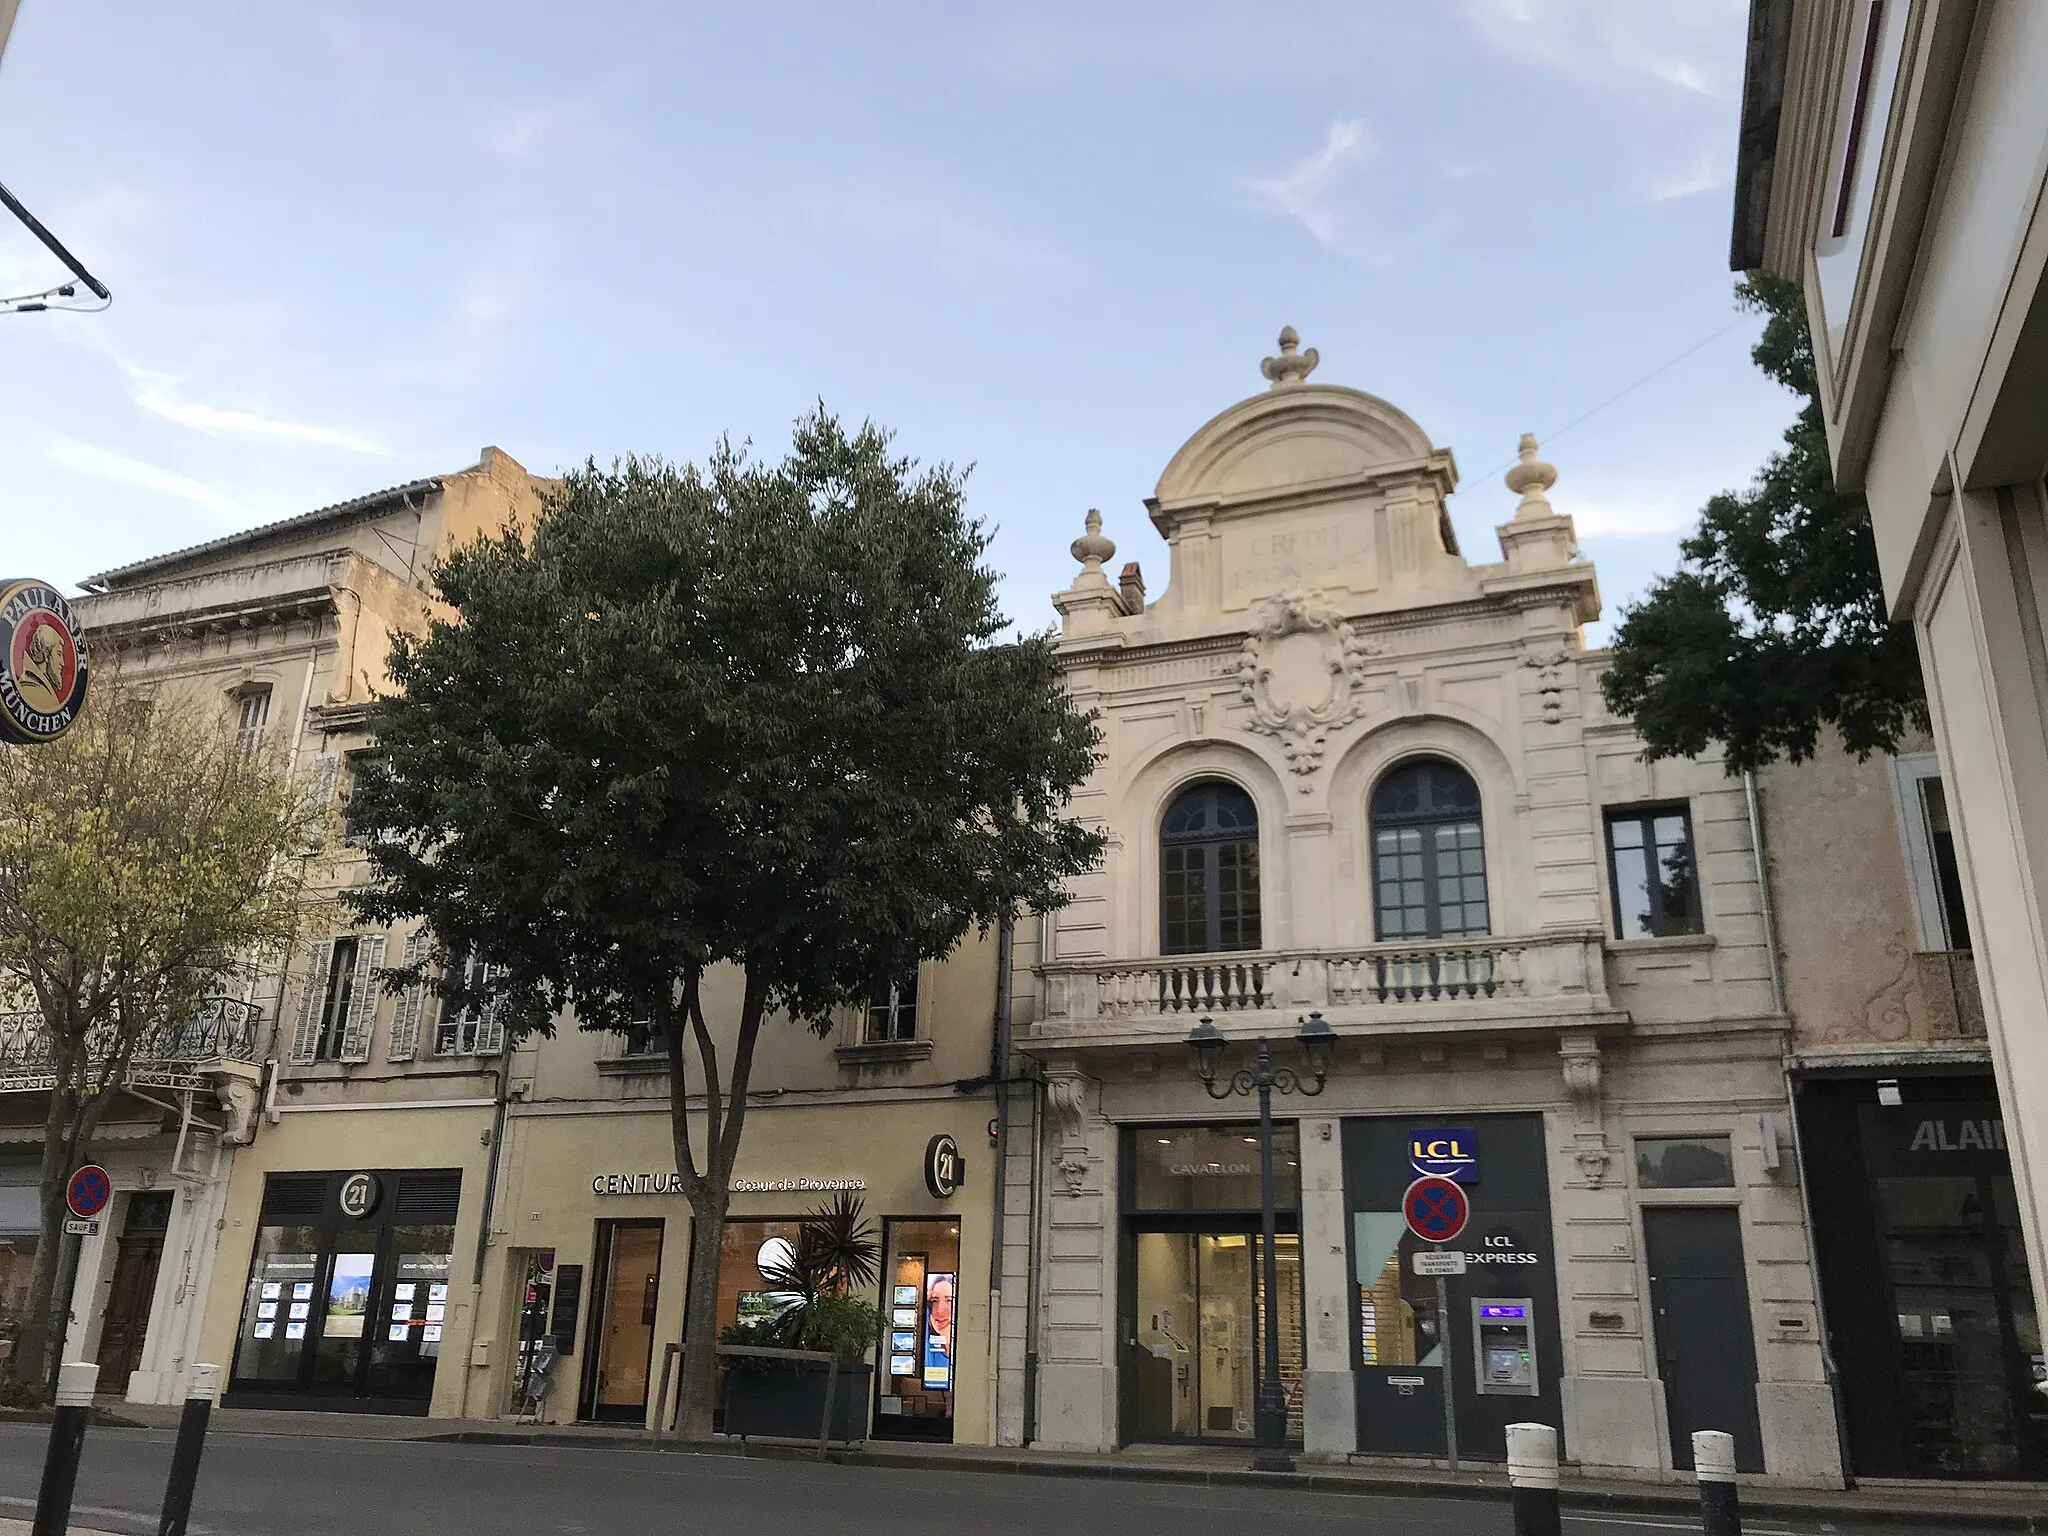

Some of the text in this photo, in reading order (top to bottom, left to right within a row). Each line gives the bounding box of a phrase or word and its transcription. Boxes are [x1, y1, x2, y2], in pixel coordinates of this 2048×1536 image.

[2, 587, 88, 673] PAULANER
[1413, 1140, 1469, 1158] LCL
[1171, 1163, 1251, 1174] CAVAILLON
[592, 1173, 685, 1194] CENTUR
[777, 1177, 796, 1191] de
[799, 1177, 865, 1191] Provence
[68, 1223, 89, 1231] SAUF
[1484, 1236, 1514, 1247] LCL
[1465, 1253, 1538, 1264] EXPRESS
